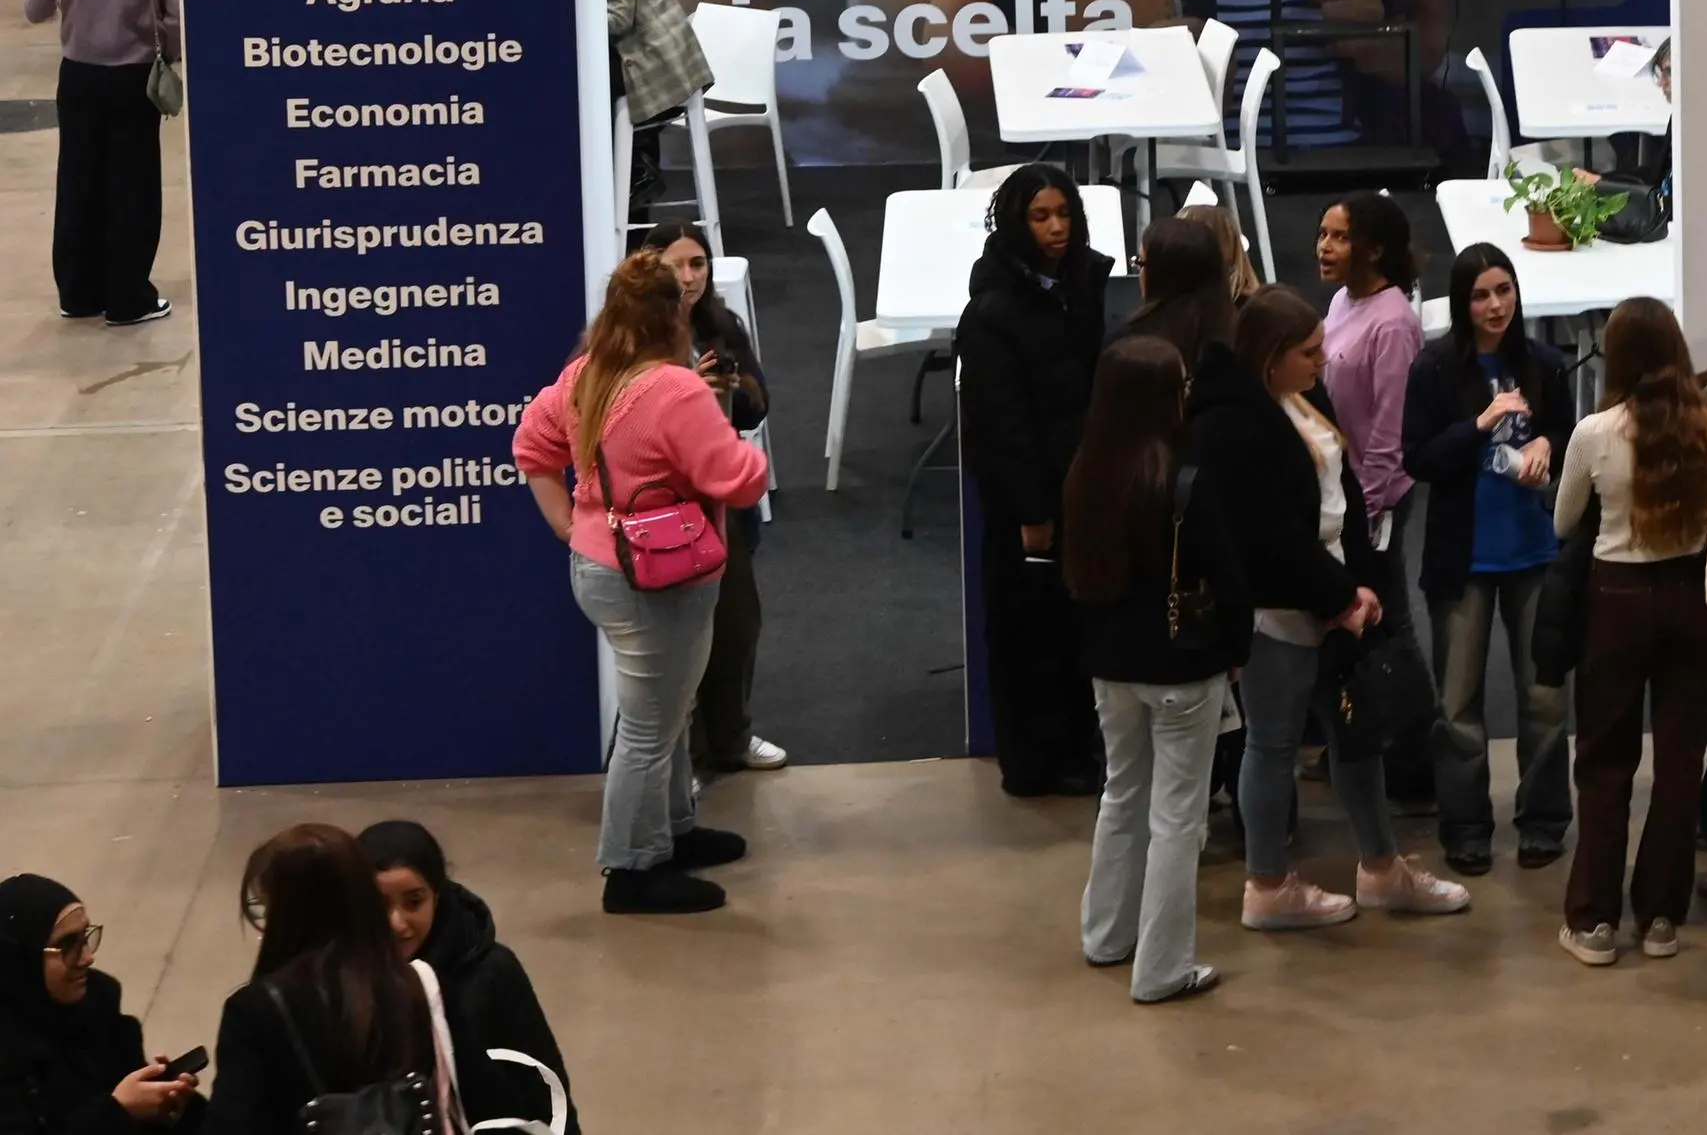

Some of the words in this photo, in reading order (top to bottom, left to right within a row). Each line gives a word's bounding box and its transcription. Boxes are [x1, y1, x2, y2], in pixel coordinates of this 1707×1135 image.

[243, 33, 523, 71] Biotecnologie
[286, 95, 484, 128] Economia
[295, 156, 480, 189] Farmacia
[235, 217, 544, 255] Giurisprudenza
[285, 276, 501, 317] Ingegneria
[303, 338, 487, 371] Medicina
[235, 402, 394, 433] Scienze
[224, 463, 383, 494] Scienze
[320, 503, 344, 529] e
[353, 495, 483, 528] sociali
